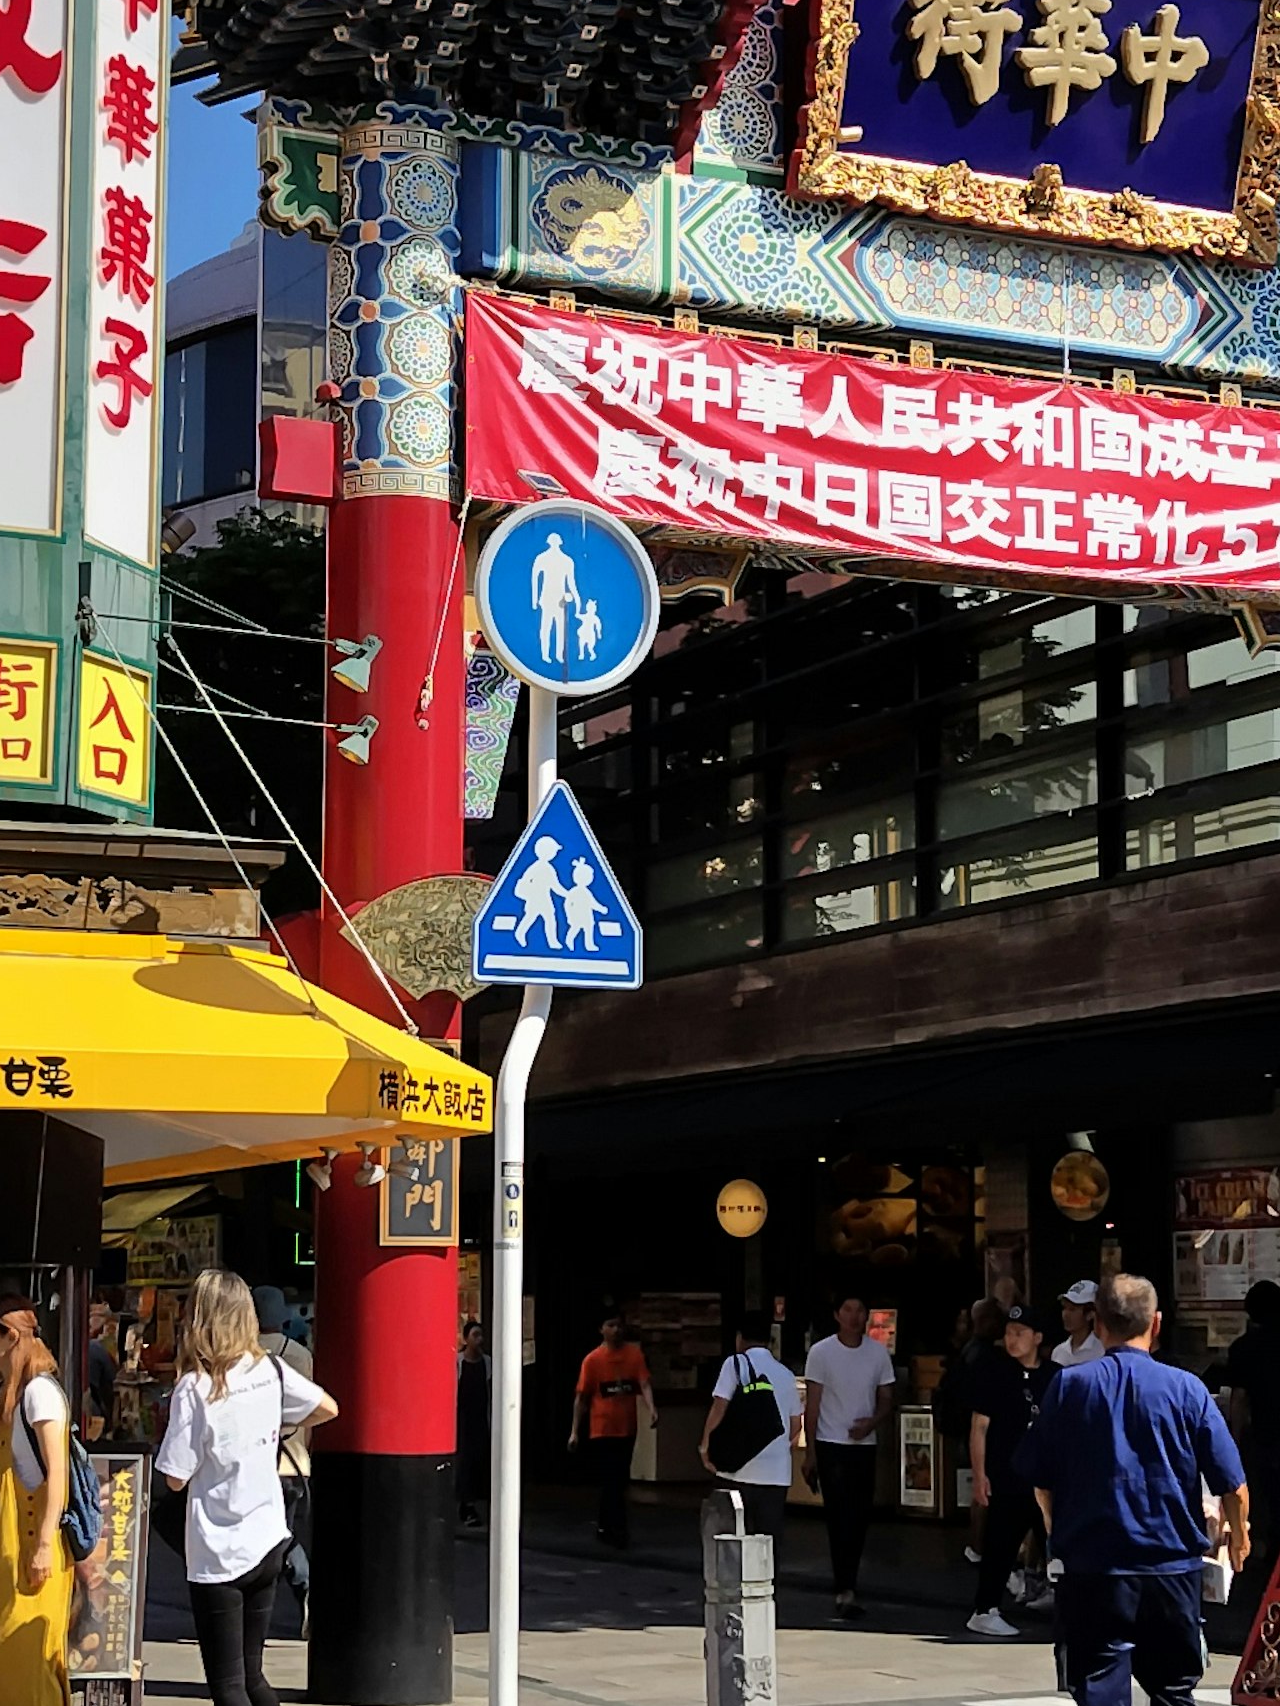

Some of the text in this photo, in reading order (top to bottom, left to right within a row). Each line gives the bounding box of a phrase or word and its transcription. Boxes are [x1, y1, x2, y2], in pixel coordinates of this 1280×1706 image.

[87, 672, 134, 785] 入口
[378, 1067, 486, 1122] 横浜大飯店
